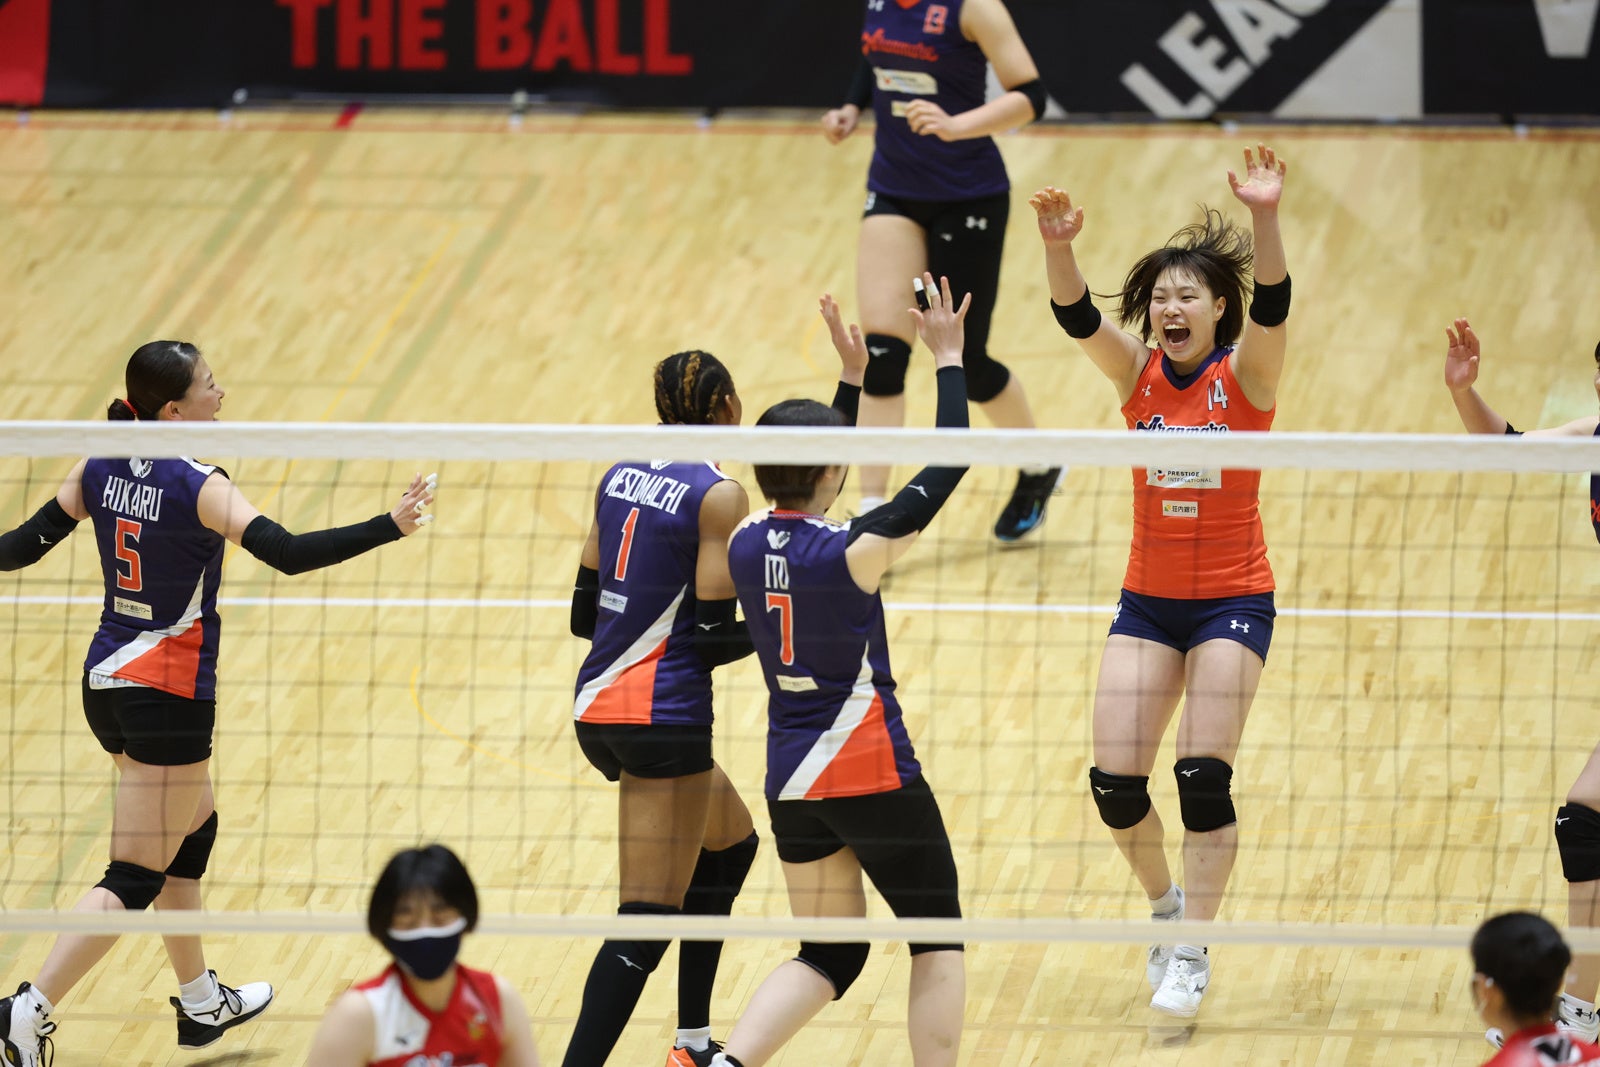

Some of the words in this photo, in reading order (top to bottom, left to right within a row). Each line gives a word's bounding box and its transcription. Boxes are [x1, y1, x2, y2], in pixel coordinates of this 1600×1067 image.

[277, 0, 447, 69] THE
[474, 0, 693, 75] BALL
[1120, 0, 1329, 118] LEA
[1207, 377, 1229, 411] 14
[101, 475, 164, 522] HIKARU
[604, 467, 690, 515] MESOMACHI
[115, 516, 143, 592] 5
[614, 507, 640, 582] 1
[764, 554, 790, 590] ITO
[764, 591, 795, 666] 7
